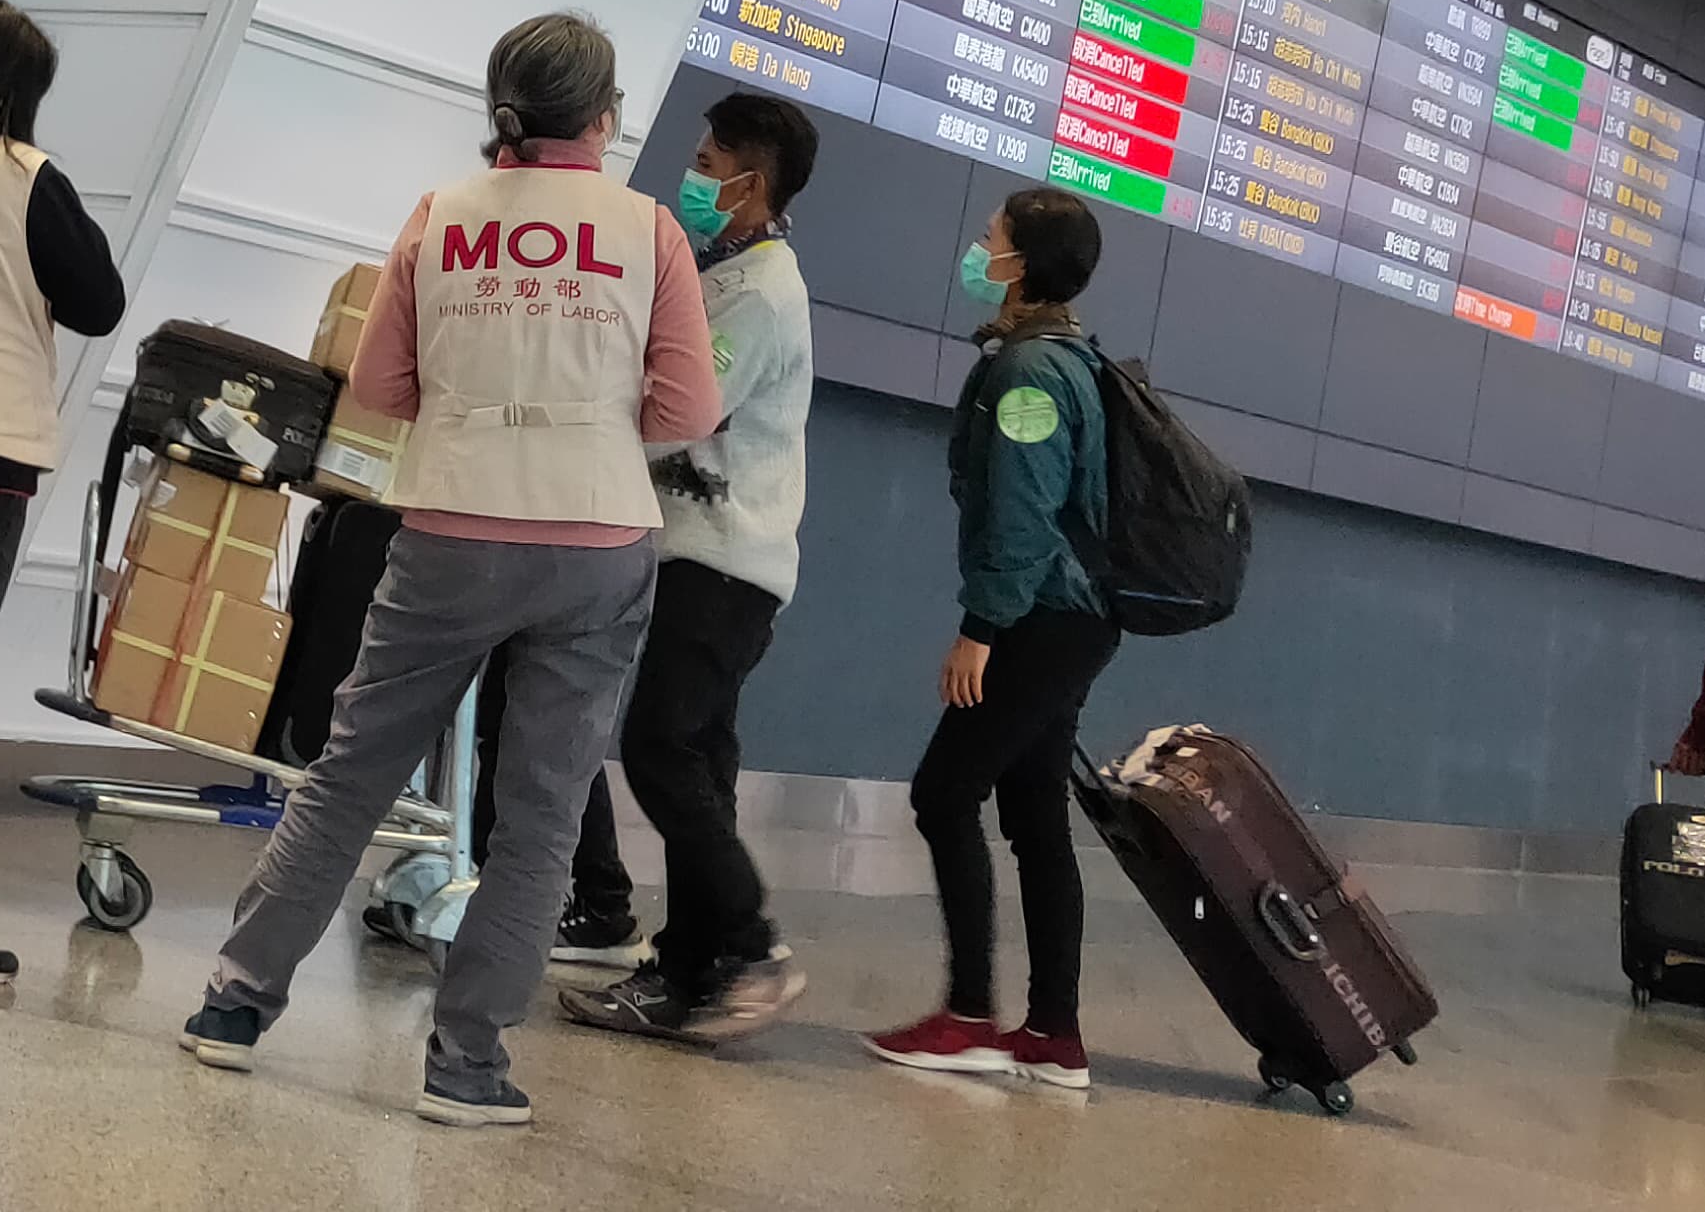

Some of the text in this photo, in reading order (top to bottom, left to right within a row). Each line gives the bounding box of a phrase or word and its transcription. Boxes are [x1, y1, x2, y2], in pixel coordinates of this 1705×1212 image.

[785, 16, 845, 57] Singapore
[1020, 14, 1052, 46] CX400
[1240, 23, 1269, 52] 15:15
[762, 52, 777, 78] Da
[781, 62, 811, 91] Nang
[954, 32, 1048, 87] 國泰港龍 KA5400
[1232, 61, 1262, 89] 15:15
[946, 73, 1036, 125] 中華航空 CI752
[1225, 97, 1255, 125] 15:25
[996, 132, 1027, 163] VJ908
[1218, 133, 1248, 161] 15:25
[1211, 169, 1240, 197] 15:25
[1204, 205, 1233, 233] 15:35
[441, 221, 624, 279] MOL
[474, 275, 582, 300] 勞動部
[439, 301, 621, 326] MINISTRY OF LABOR
[1323, 963, 1390, 1050] ICHIB
